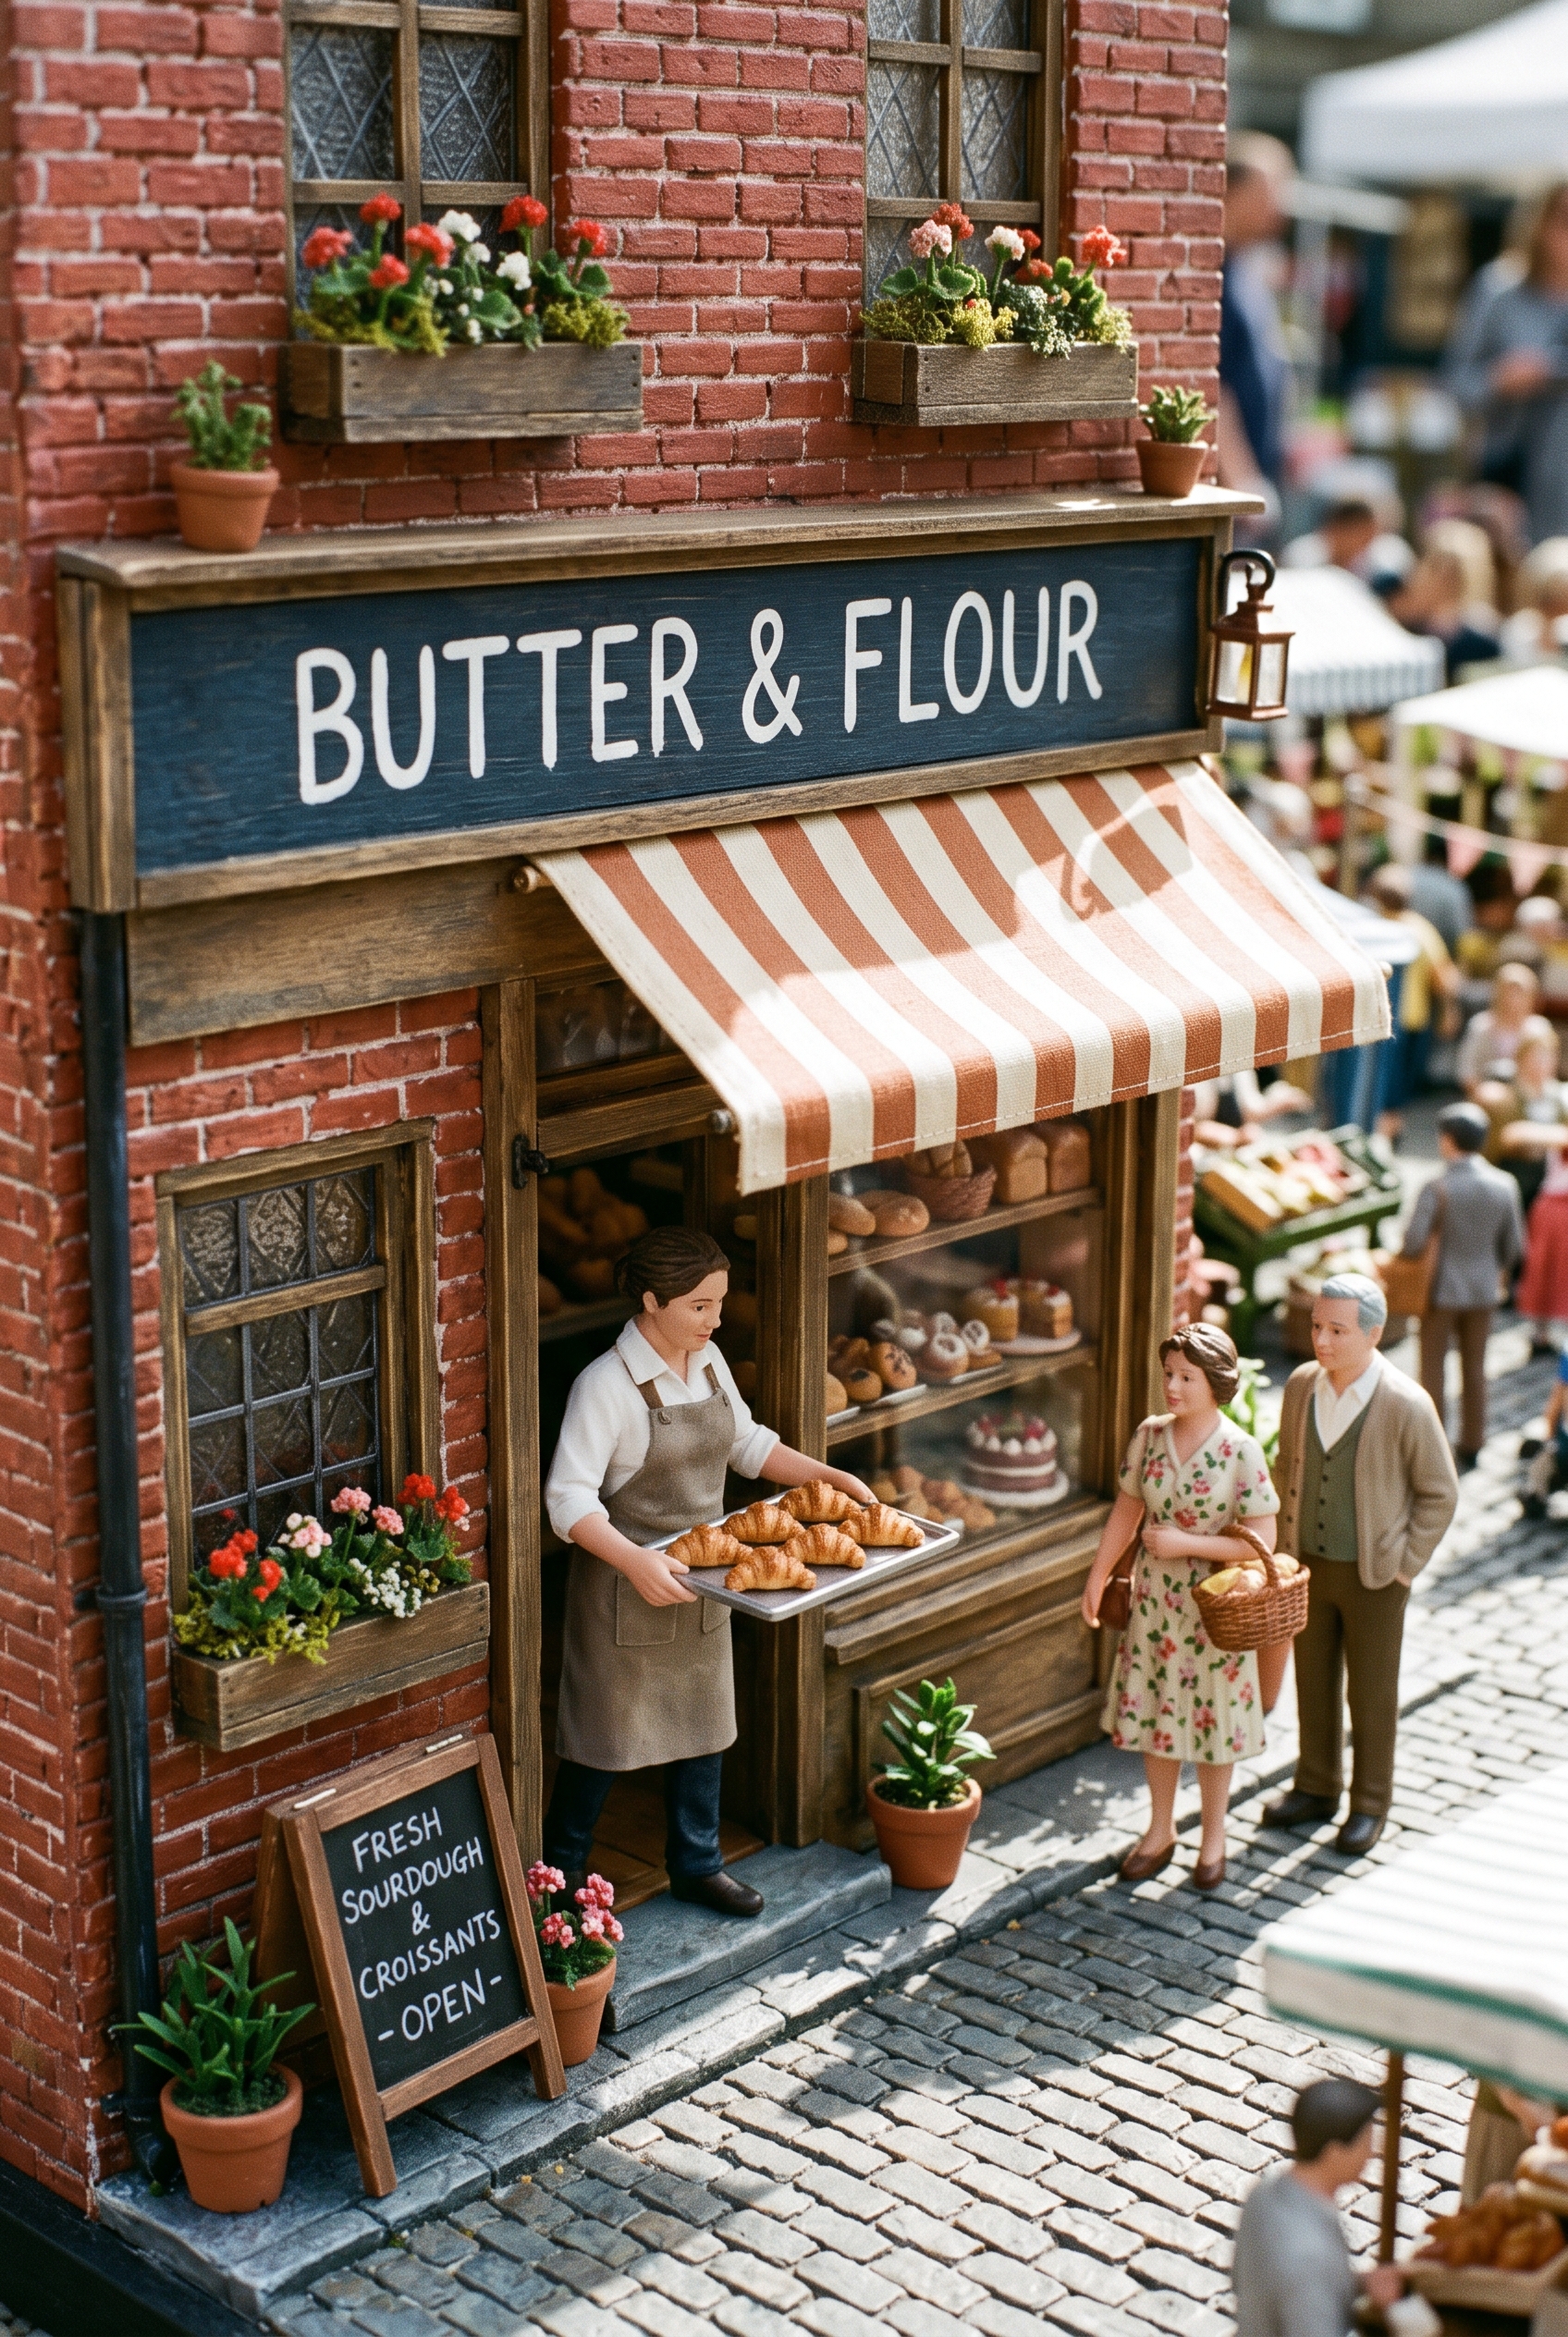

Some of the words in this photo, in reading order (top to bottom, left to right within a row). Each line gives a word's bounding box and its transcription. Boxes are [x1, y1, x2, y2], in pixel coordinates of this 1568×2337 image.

[295, 617, 704, 806] BUTTER
[741, 607, 803, 745] &
[842, 580, 1103, 734] FLOUR
[341, 1836, 484, 1925] SOURDOUGH
[351, 1805, 443, 1874] FRESH
[359, 1909, 501, 2000] CROISSANTS
[410, 1901, 431, 1936] &
